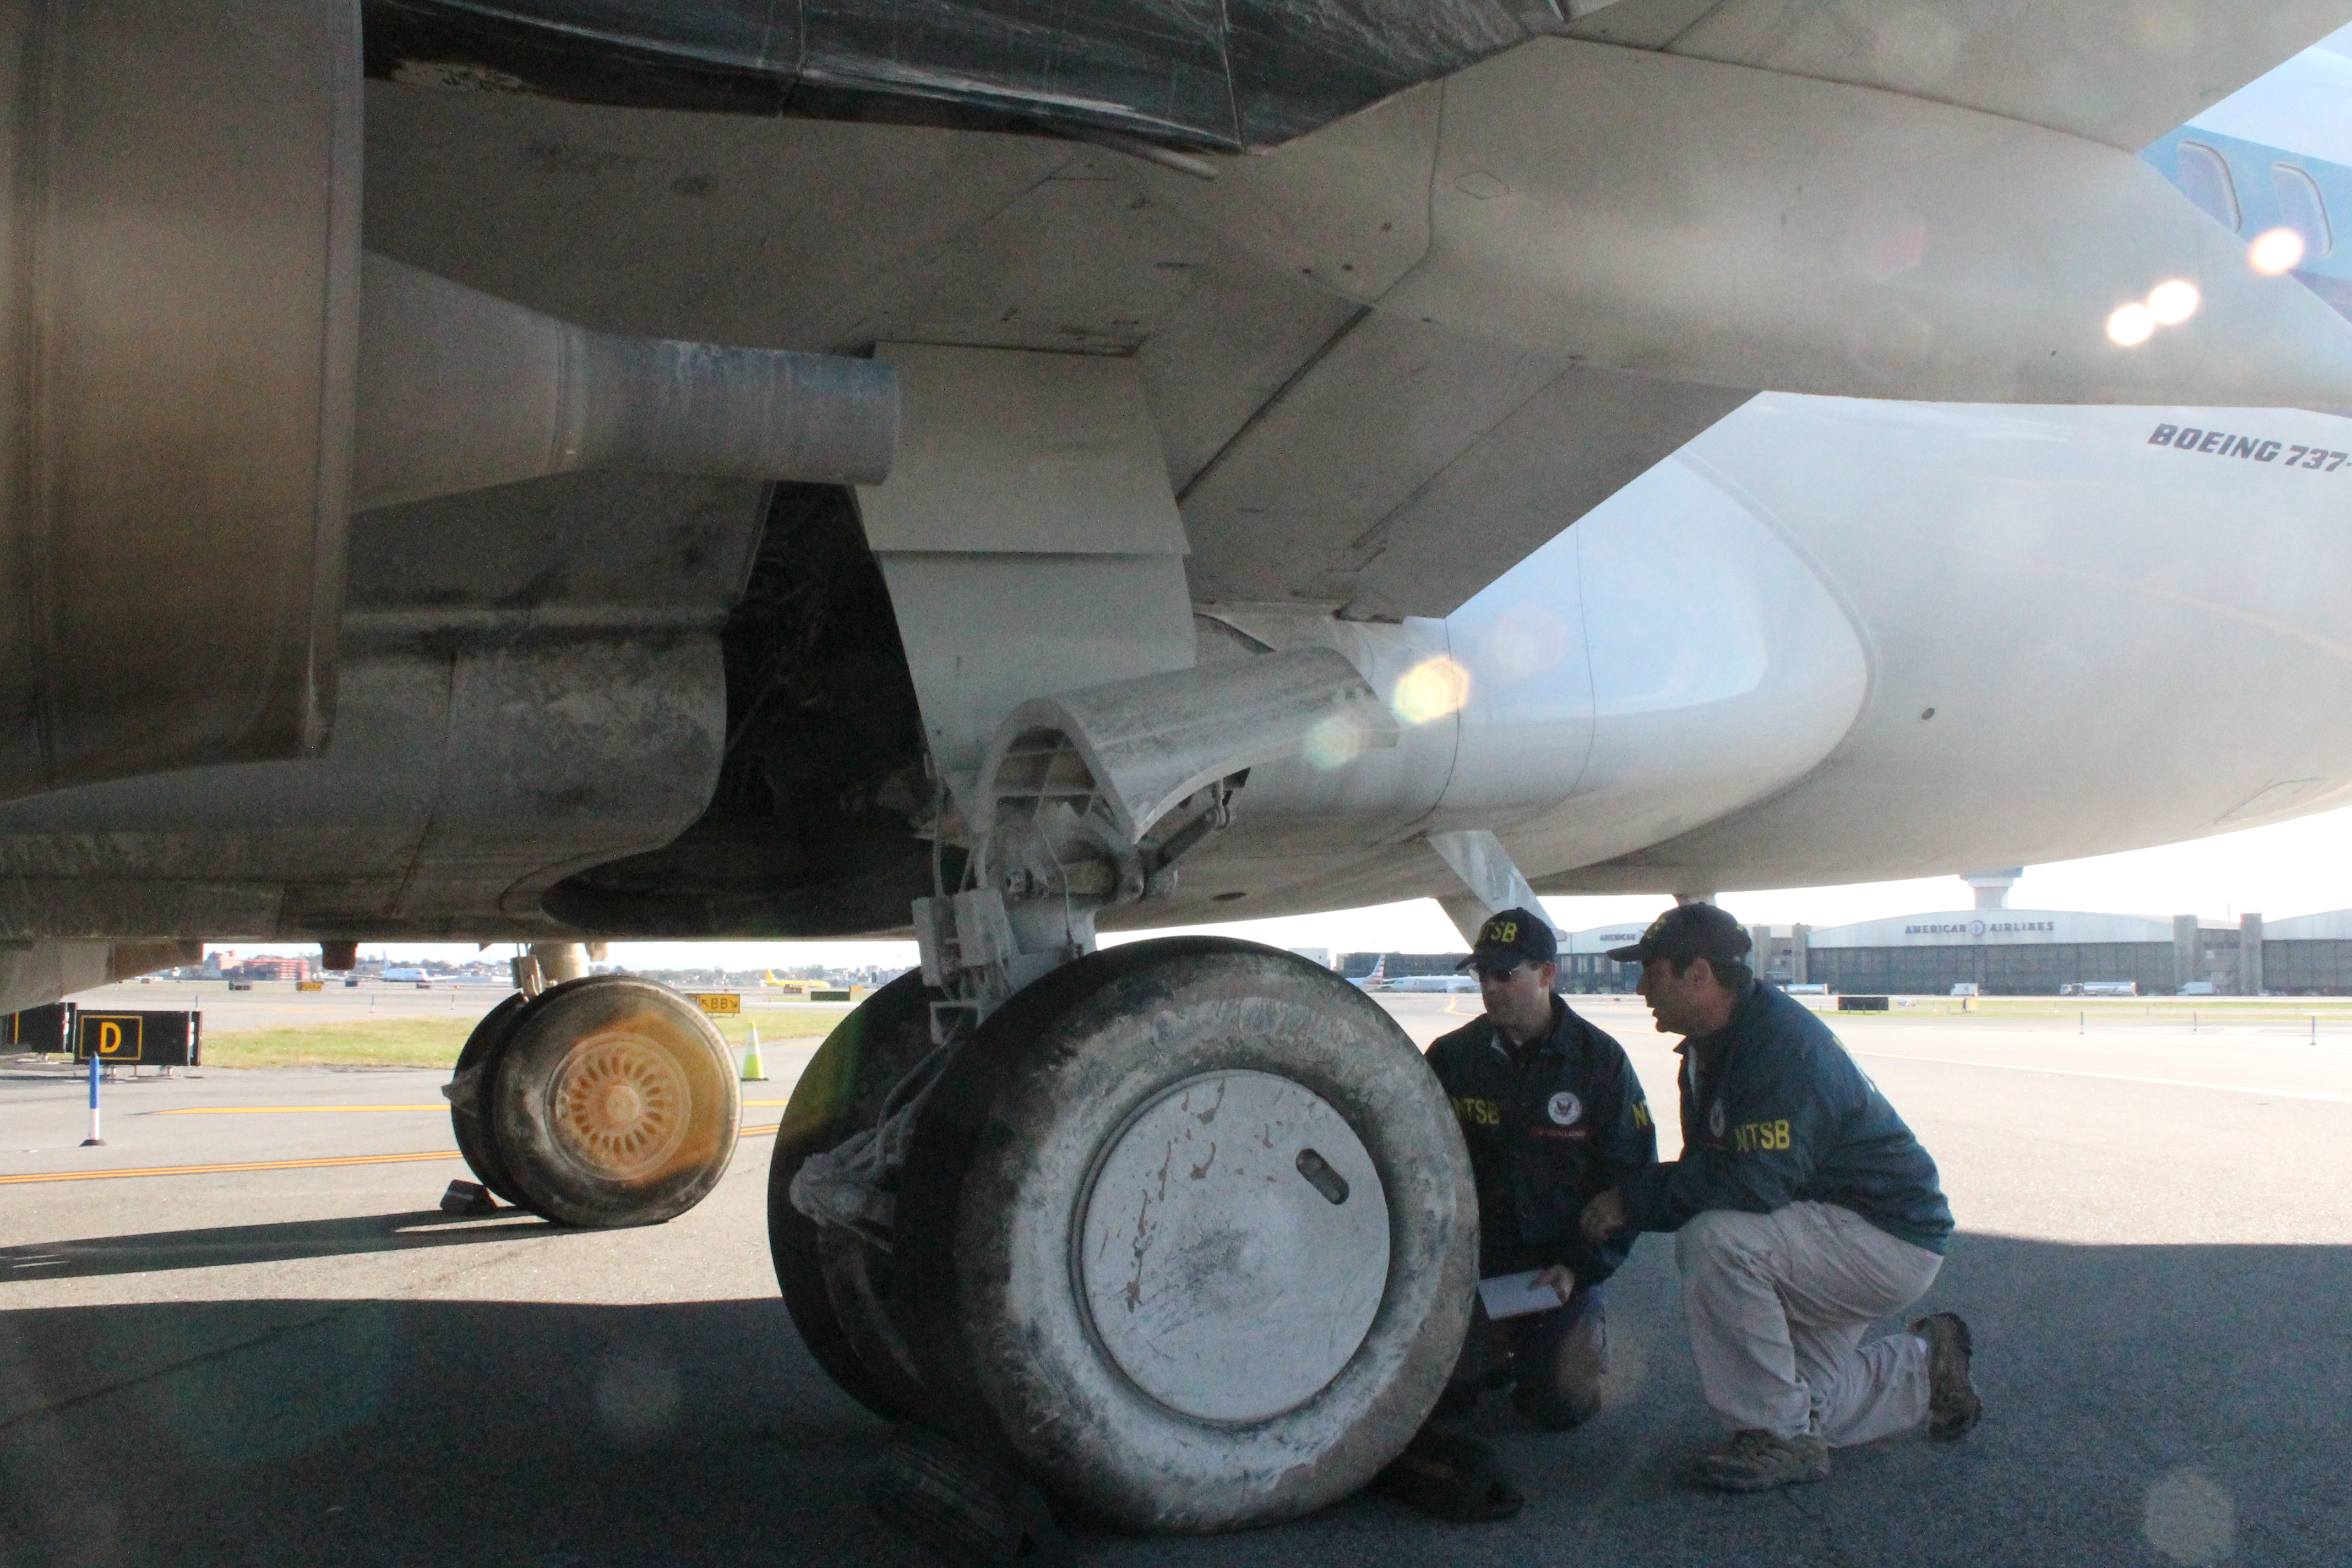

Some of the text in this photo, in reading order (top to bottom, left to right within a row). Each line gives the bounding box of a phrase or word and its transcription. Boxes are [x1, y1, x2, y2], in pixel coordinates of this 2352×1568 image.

[2147, 423, 2282, 462] BOEING
[1480, 921, 1517, 943] TSB
[1905, 922, 2054, 934] AMERICAN AIRLINES
[711, 998, 728, 1009] BB
[99, 1021, 122, 1054] D
[1632, 1100, 1648, 1129] N
[1735, 1119, 1791, 1152] NTSB
